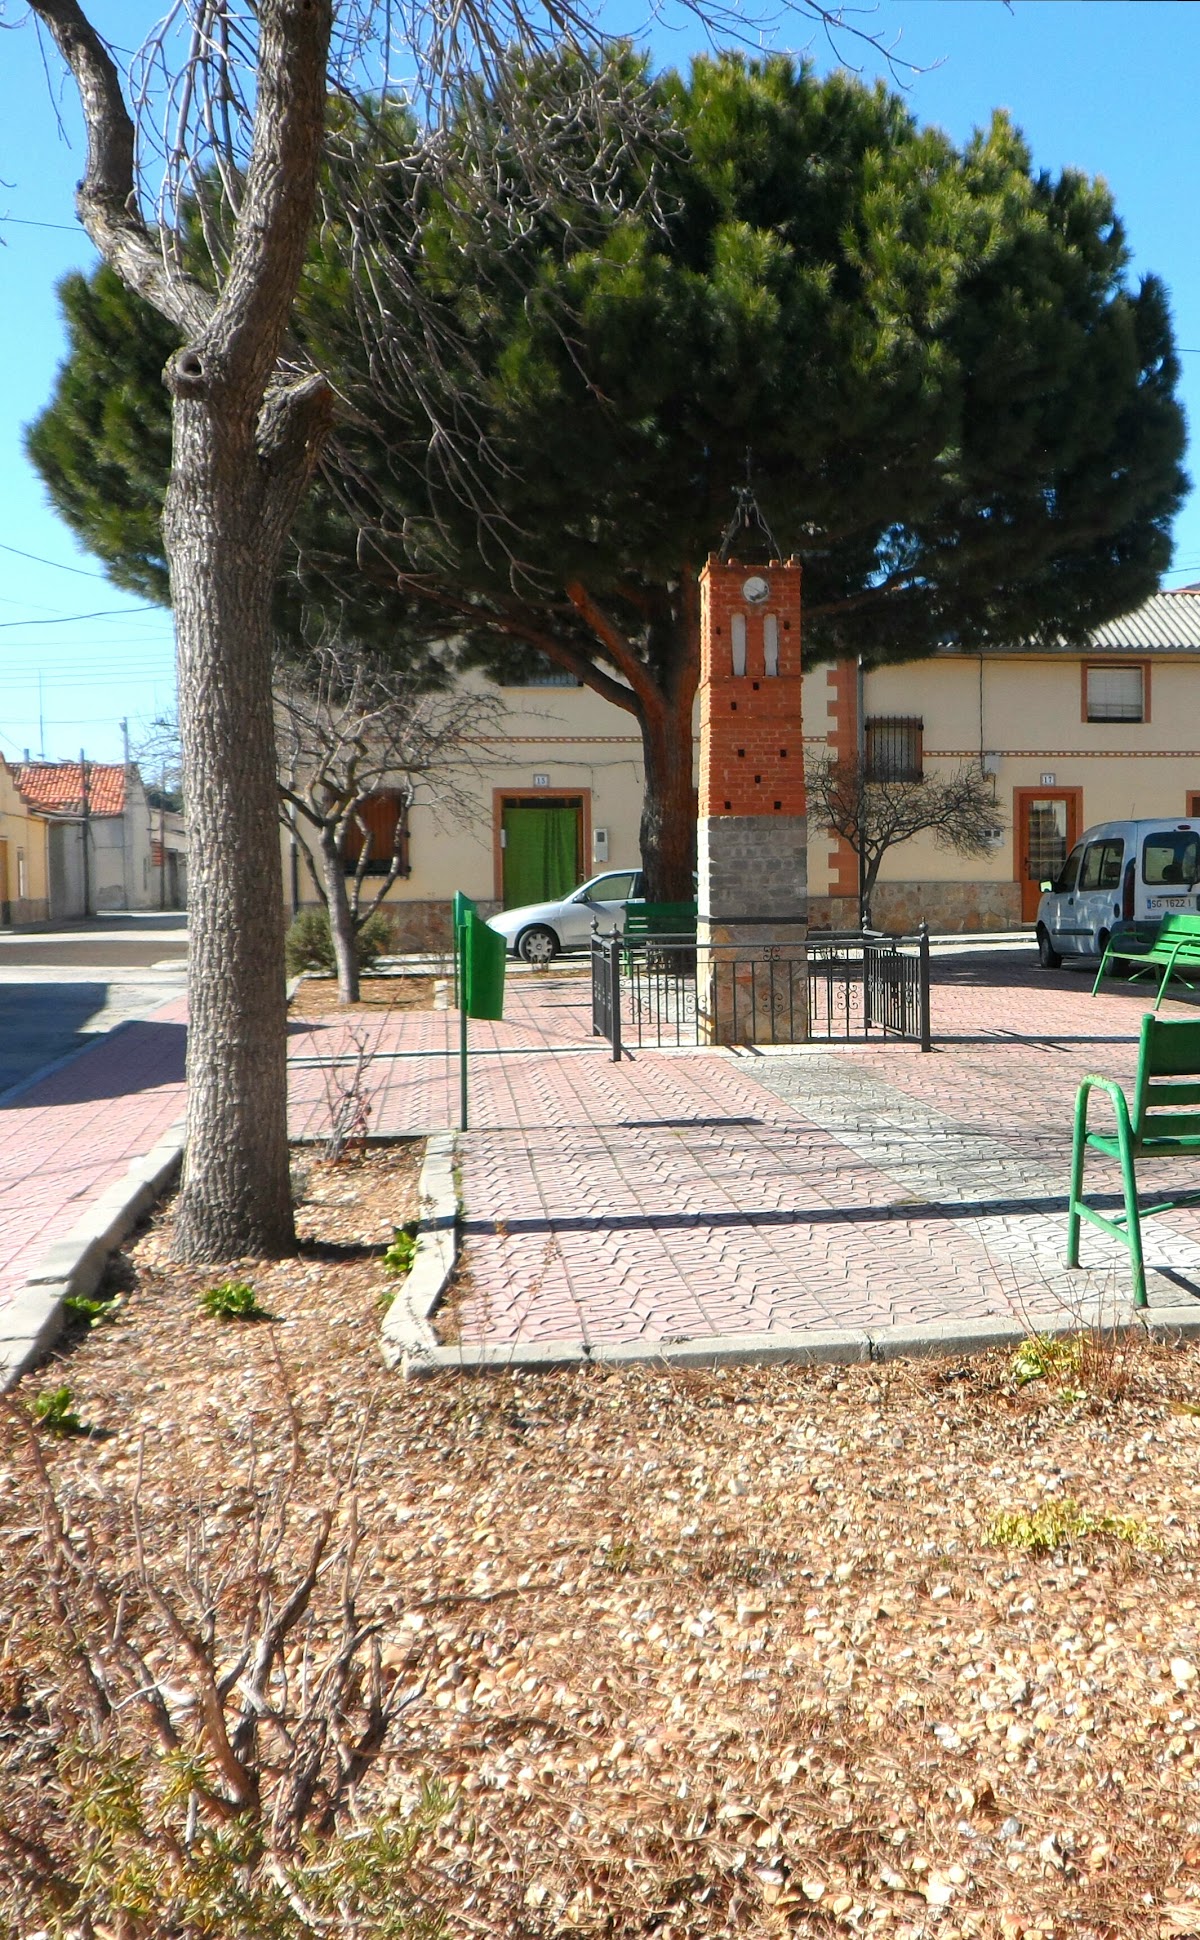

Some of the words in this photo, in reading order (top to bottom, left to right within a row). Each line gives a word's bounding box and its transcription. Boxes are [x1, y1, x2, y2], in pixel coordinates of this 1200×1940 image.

[1044, 776, 1052, 784] 17
[1152, 899, 1161, 908] SG
[1166, 899, 1185, 907] 1622
